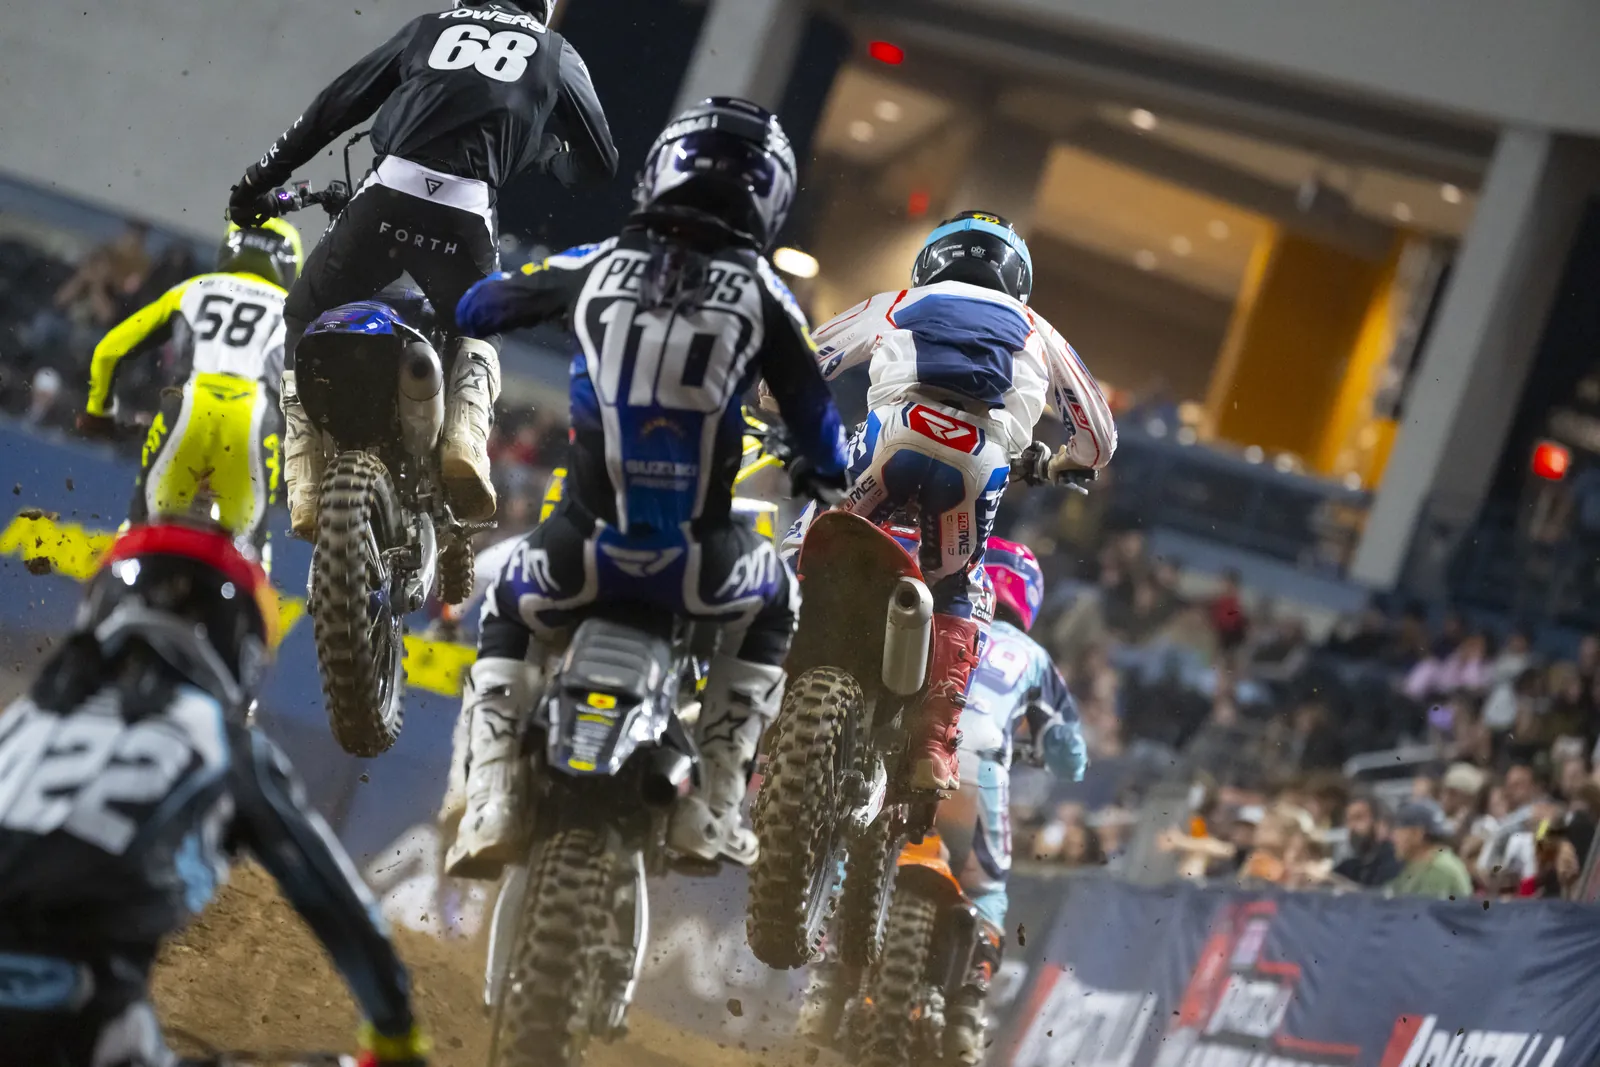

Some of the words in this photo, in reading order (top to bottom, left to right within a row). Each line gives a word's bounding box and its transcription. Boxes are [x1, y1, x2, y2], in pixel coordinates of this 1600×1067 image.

[438, 8, 547, 34] TOWERS
[427, 23, 538, 82] 68
[379, 221, 458, 254] FORTH
[599, 257, 751, 304] PERS
[195, 294, 267, 347] 58
[598, 299, 743, 412] 110
